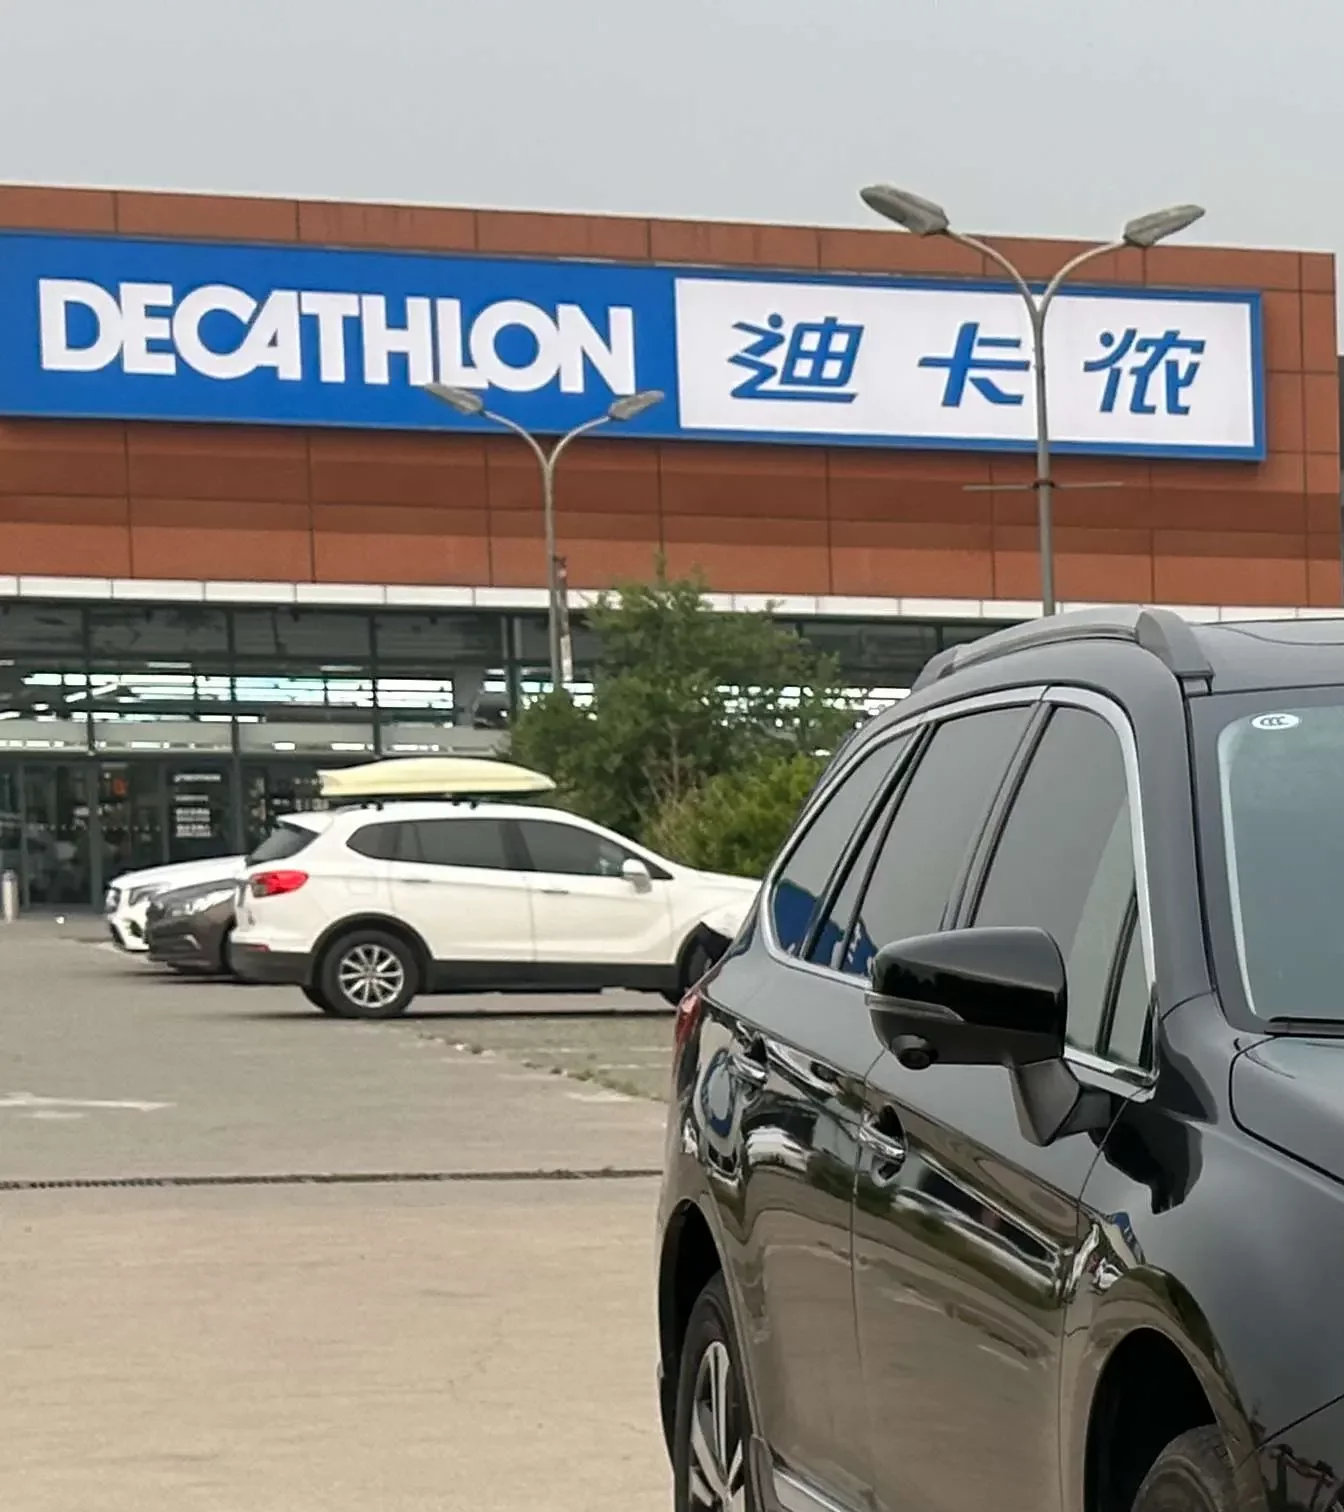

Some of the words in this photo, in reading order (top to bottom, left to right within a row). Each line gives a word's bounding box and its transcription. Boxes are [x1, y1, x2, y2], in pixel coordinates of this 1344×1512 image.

[38, 277, 637, 396] DECATHLON
[727, 313, 1205, 416] 迪卡侬
